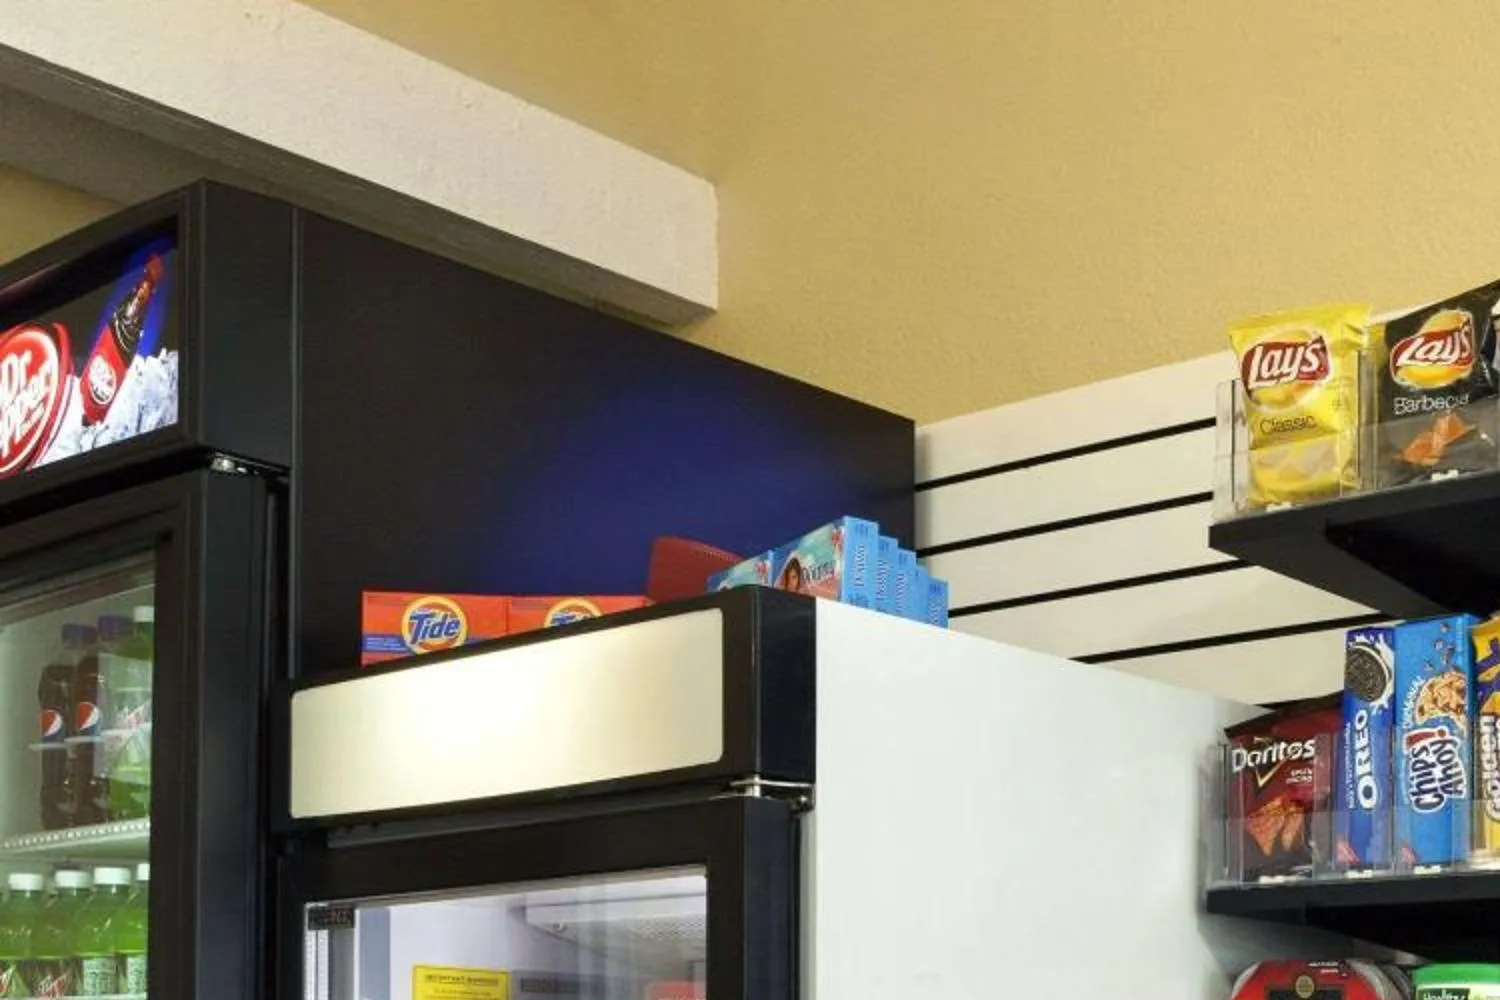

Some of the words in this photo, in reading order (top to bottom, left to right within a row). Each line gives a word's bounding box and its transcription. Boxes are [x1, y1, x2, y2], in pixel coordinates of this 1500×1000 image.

[1248, 338, 1323, 388] Lay's
[1260, 415, 1318, 435] Classic
[408, 609, 462, 645] Tide
[1231, 738, 1317, 773] Doritos
[1354, 708, 1378, 810] OREO
[1408, 745, 1445, 812] Chips
